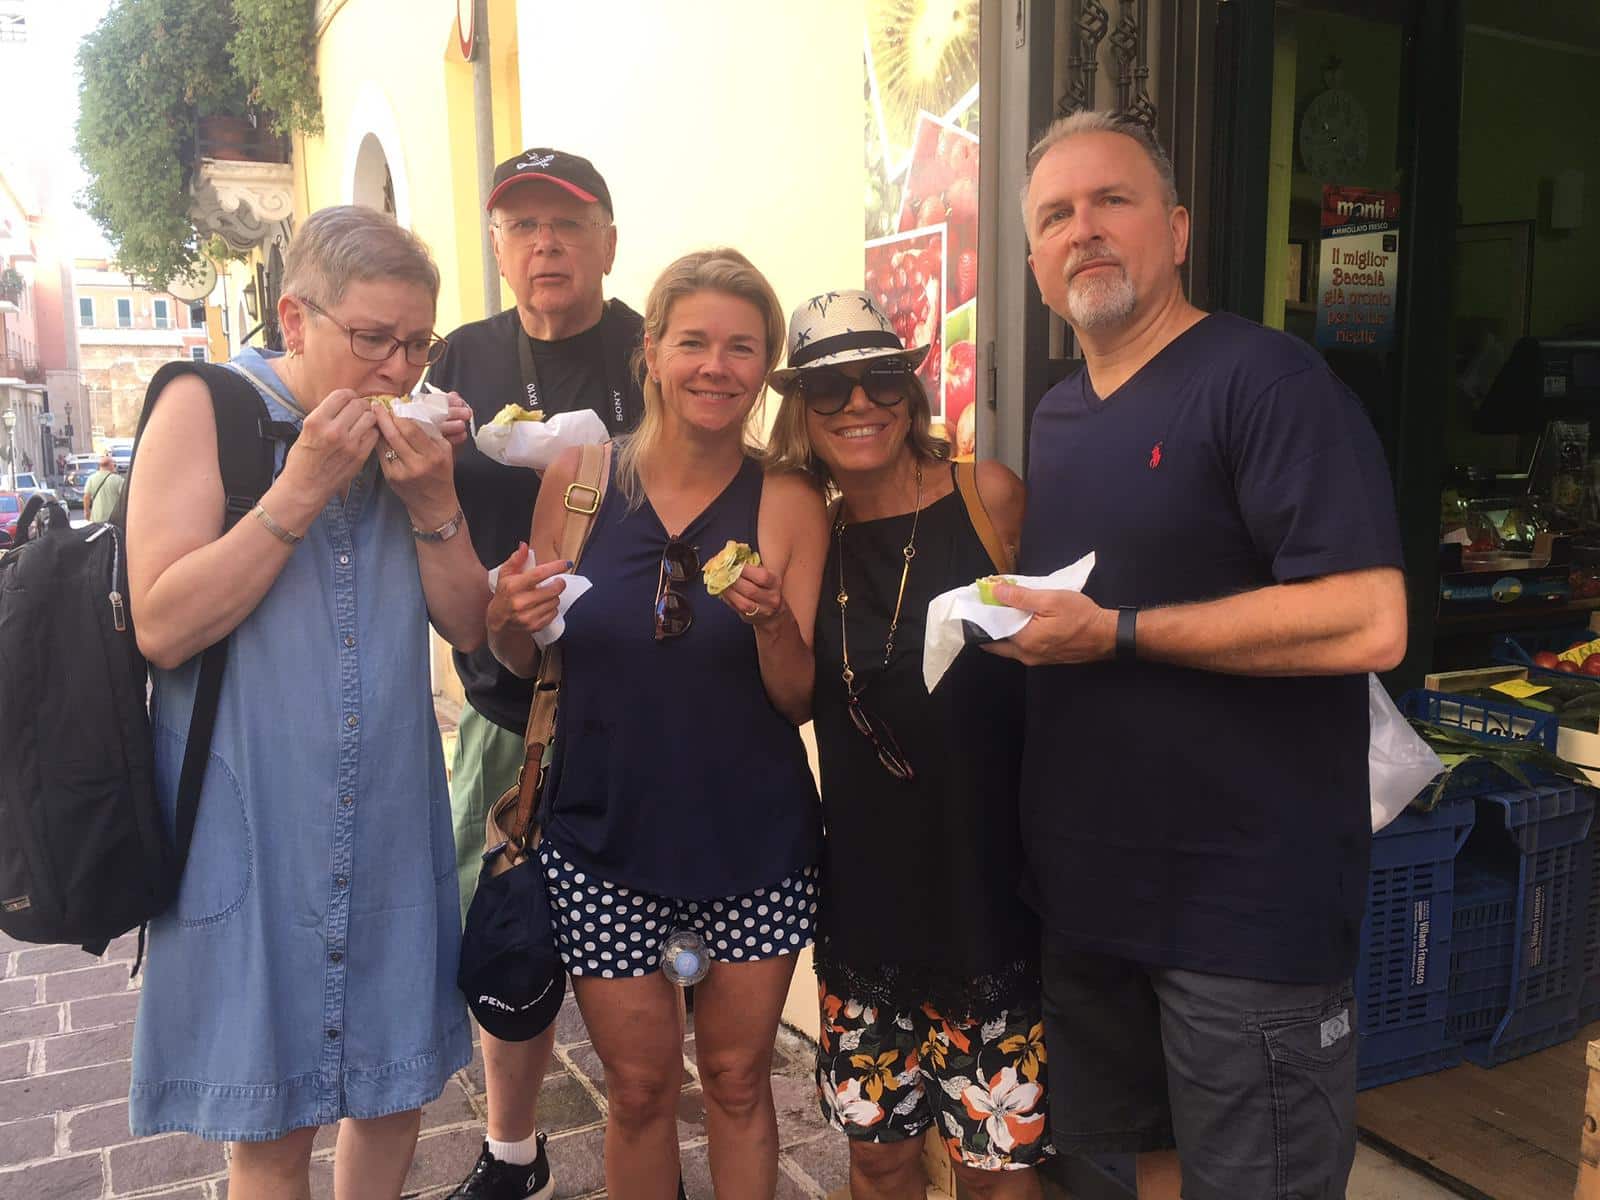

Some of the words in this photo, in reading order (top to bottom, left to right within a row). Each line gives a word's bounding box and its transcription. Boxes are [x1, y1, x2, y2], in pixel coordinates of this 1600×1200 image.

[1332, 248, 1340, 265] Il
[1343, 250, 1389, 270] miglior
[613, 390, 624, 422] SONY
[478, 995, 515, 1012] PENN
